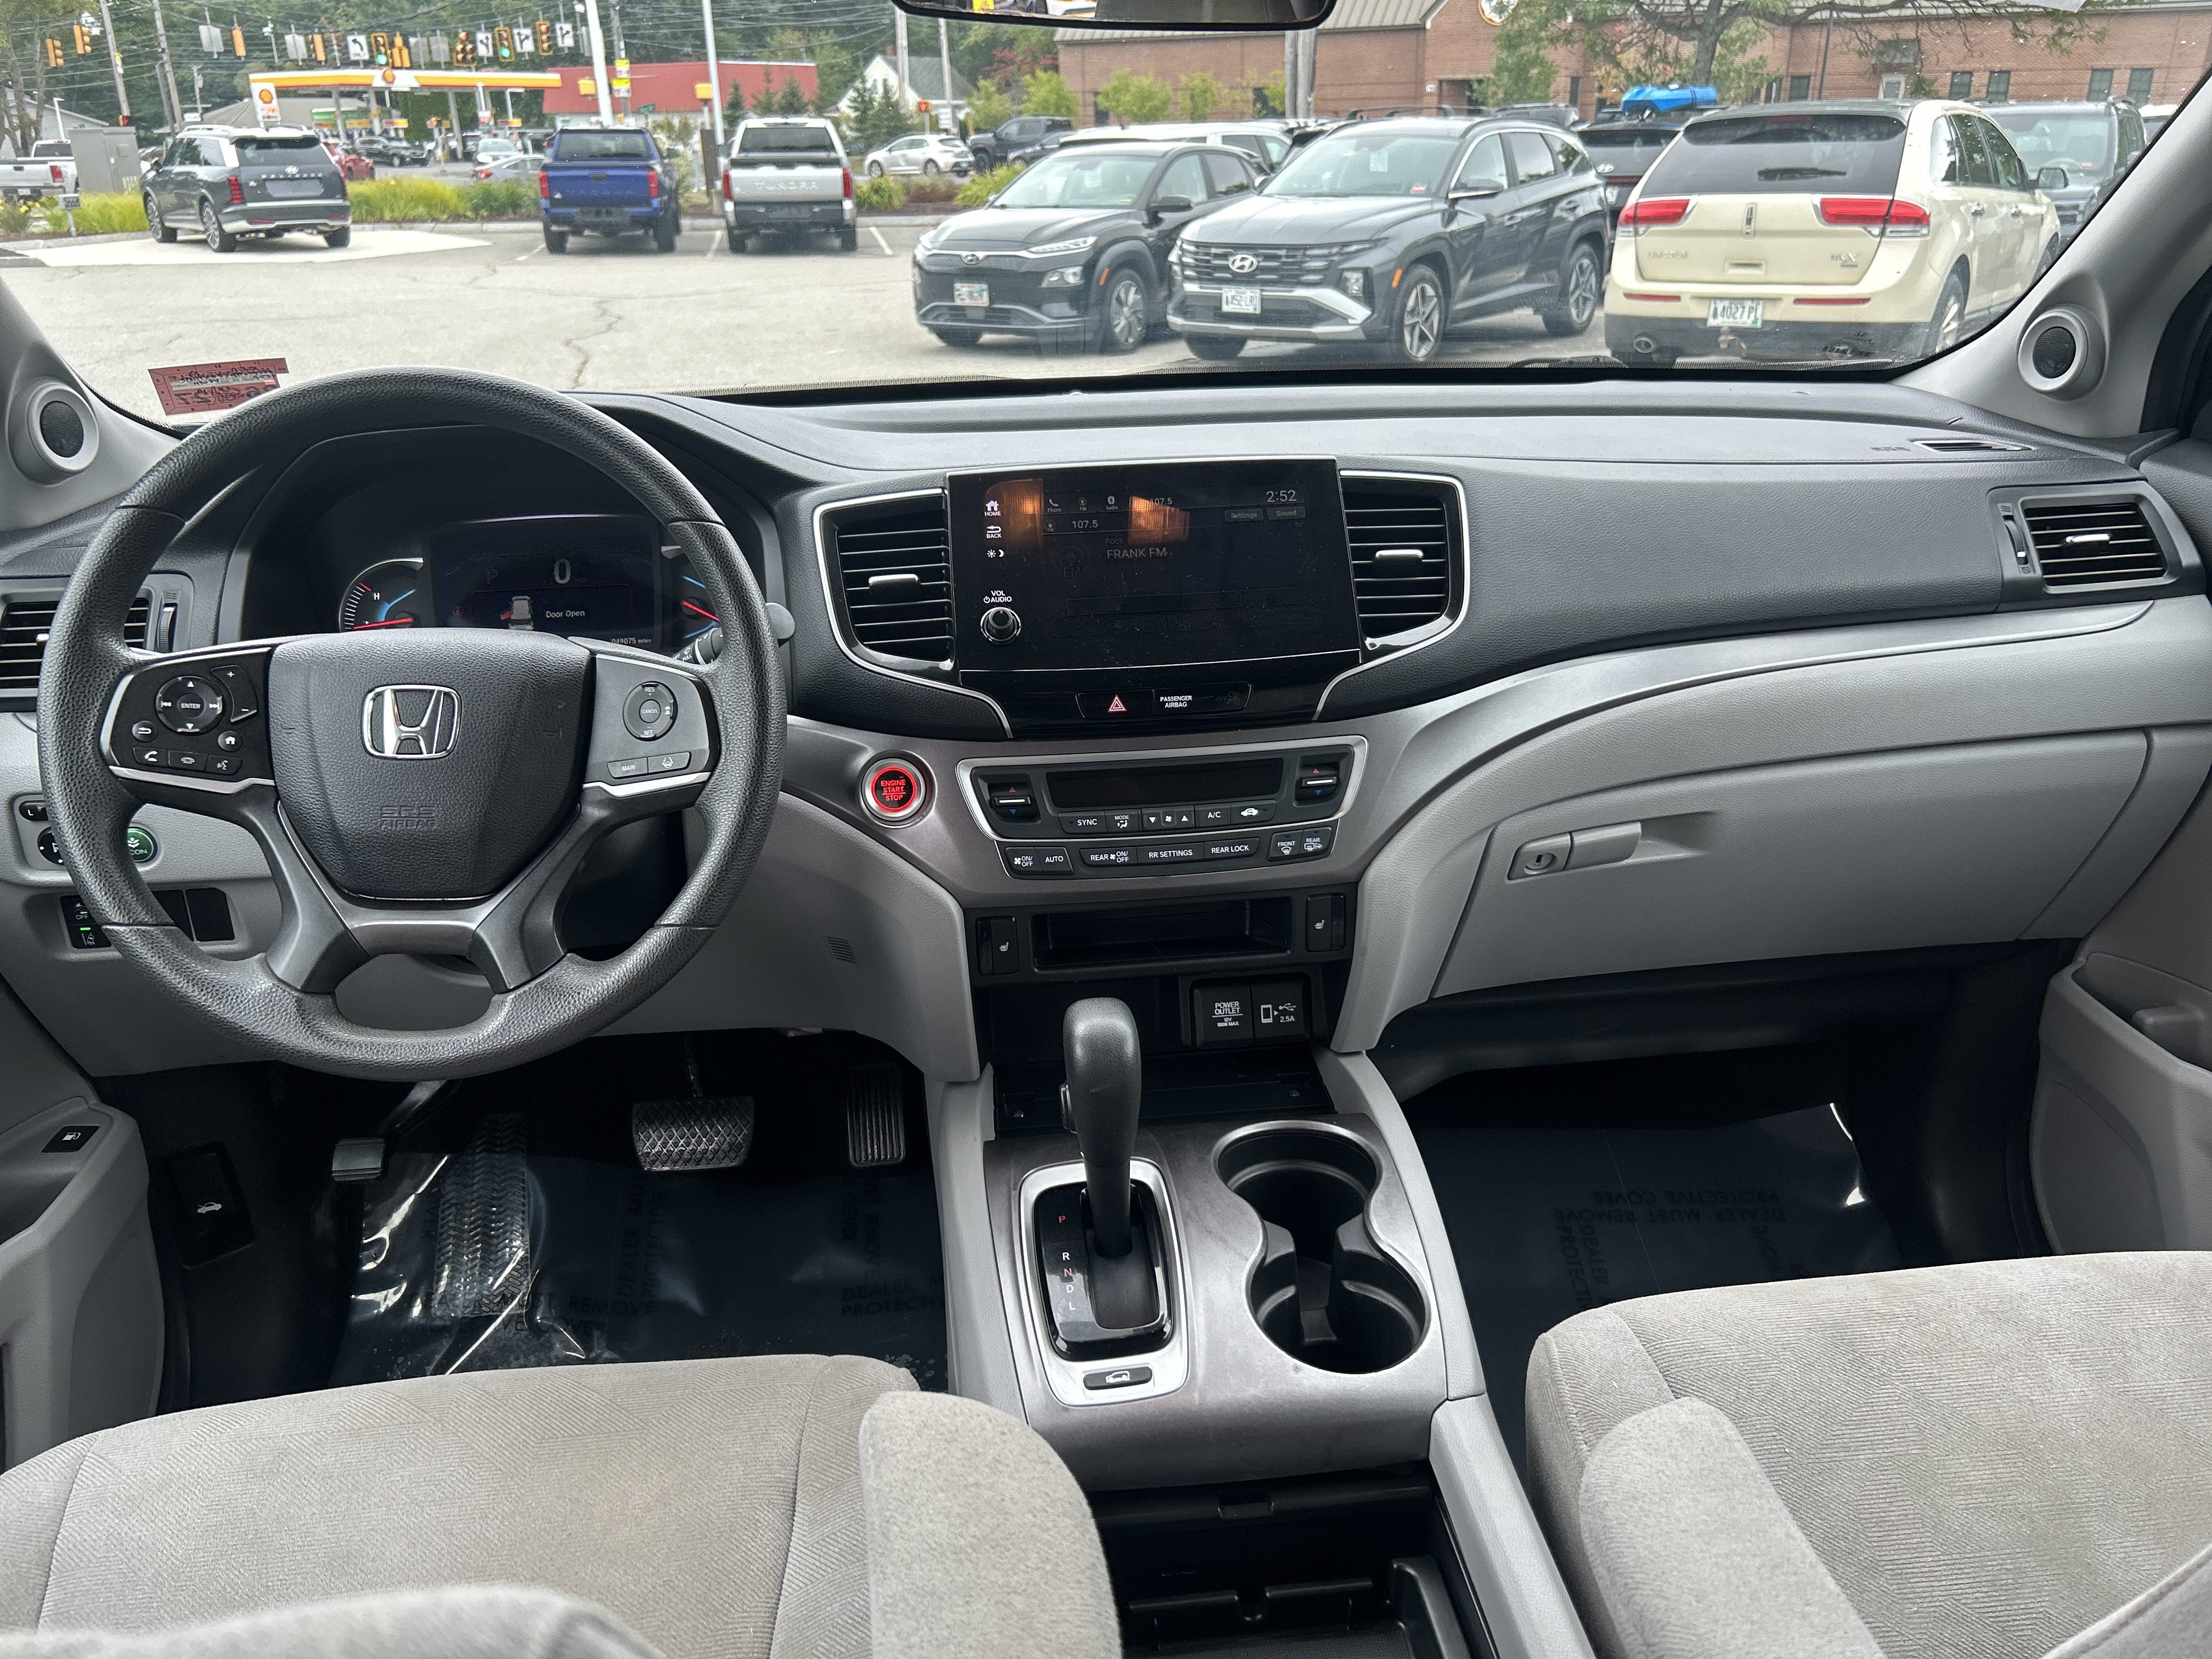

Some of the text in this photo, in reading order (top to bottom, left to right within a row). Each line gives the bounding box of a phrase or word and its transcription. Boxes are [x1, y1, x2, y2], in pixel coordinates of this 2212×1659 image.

[1265, 489, 1297, 503] 2:52
[1071, 520, 1098, 530] 107.5
[1105, 537, 1124, 546] Rock
[1107, 547, 1167, 560] FRANK FM
[554, 557, 571, 584] 0
[1063, 567, 1082, 578] FM
[545, 610, 585, 619] Door Open
[380, 805, 437, 817] SRS
[380, 819, 437, 831] AIRBAG
[1159, 849, 1193, 858] SETTINGS
[1231, 844, 1249, 853] LOCK
[1592, 1188, 1779, 1205] PROTECTIVE COVER
[1058, 1215, 1066, 1223] P
[1552, 1206, 1786, 1224] DEALER MUST REMOVE
[1062, 1252, 1070, 1261] R
[1064, 1268, 1073, 1277] N
[842, 1277, 915, 1301] DEALER
[1066, 1284, 1074, 1293] D
[569, 1294, 658, 1316] REMOVE
[1069, 1301, 1076, 1310] L
